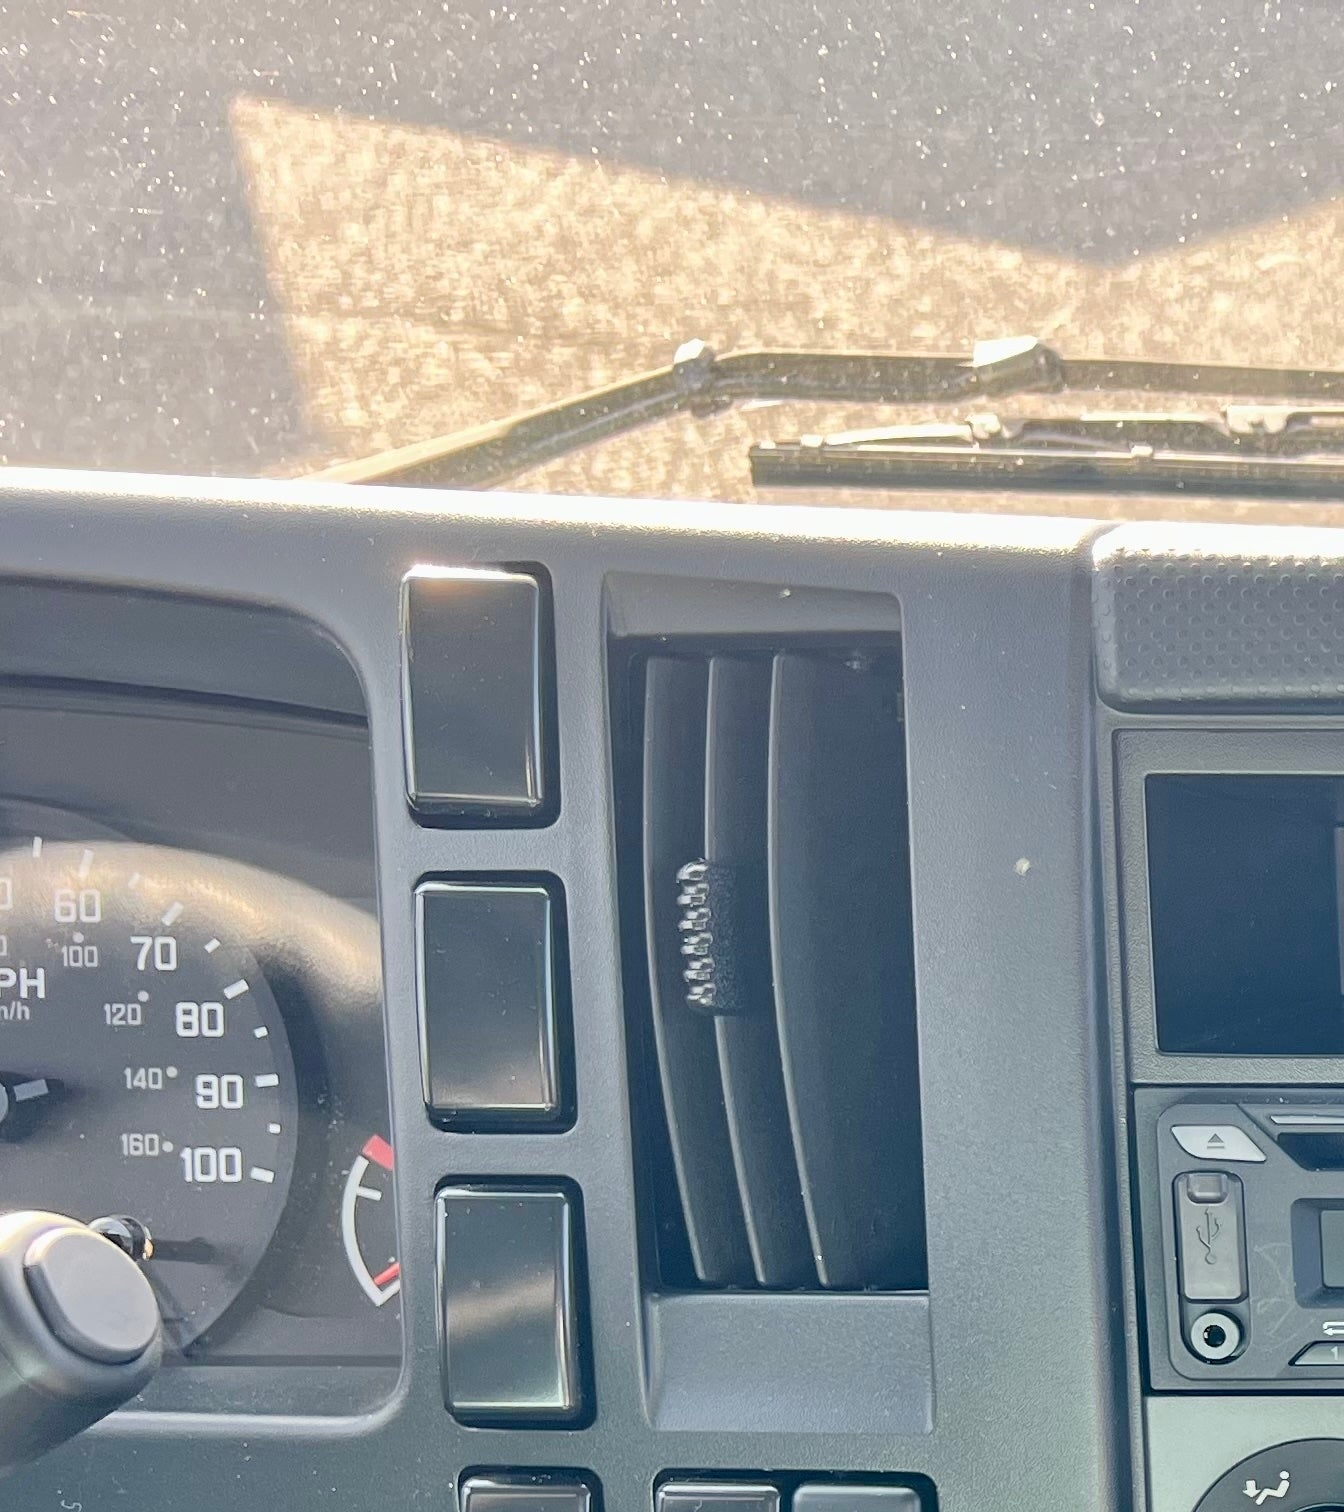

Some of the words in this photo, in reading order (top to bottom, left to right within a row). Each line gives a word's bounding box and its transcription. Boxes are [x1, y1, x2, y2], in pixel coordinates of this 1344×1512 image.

[55, 889, 101, 923] 60
[61, 945, 98, 967] 100
[130, 936, 177, 971] 70
[103, 1003, 142, 1025] 120
[175, 1001, 225, 1038] 80
[123, 1067, 163, 1090] 140
[195, 1074, 244, 1109] 90
[121, 1133, 160, 1157] 160
[180, 1147, 243, 1183] 100
[1331, 1346, 1339, 1361] 1
